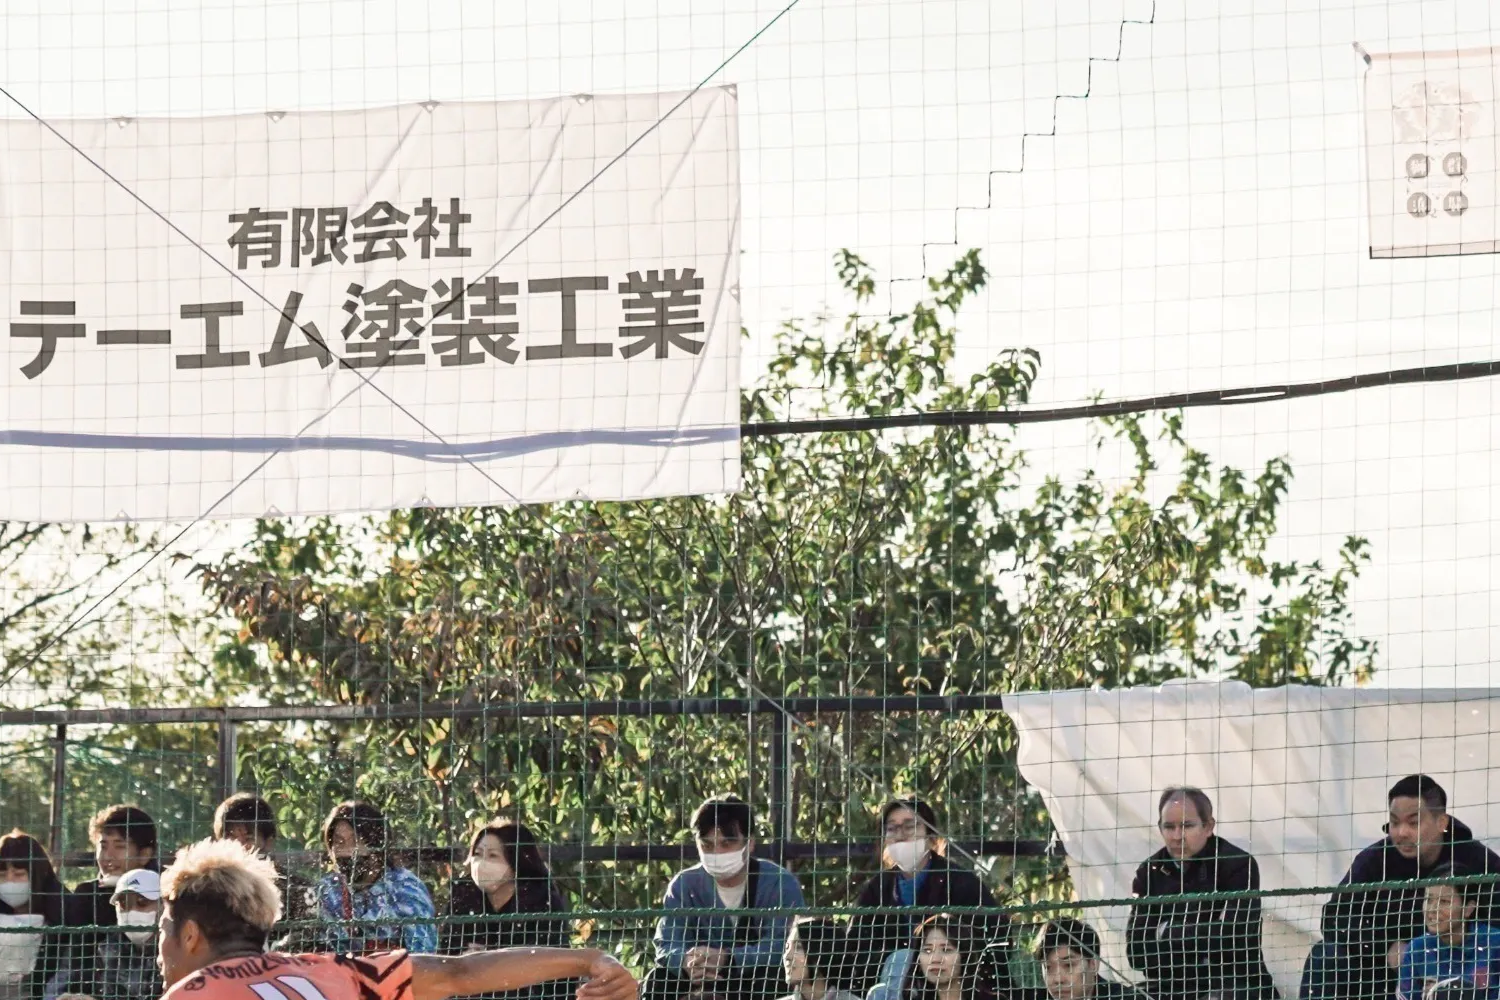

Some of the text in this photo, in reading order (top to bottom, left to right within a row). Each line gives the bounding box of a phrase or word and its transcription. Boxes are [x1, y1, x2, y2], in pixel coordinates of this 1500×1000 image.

[227, 197, 472, 270] 有限会社
[8, 267, 706, 380] テーエム塗装工業
